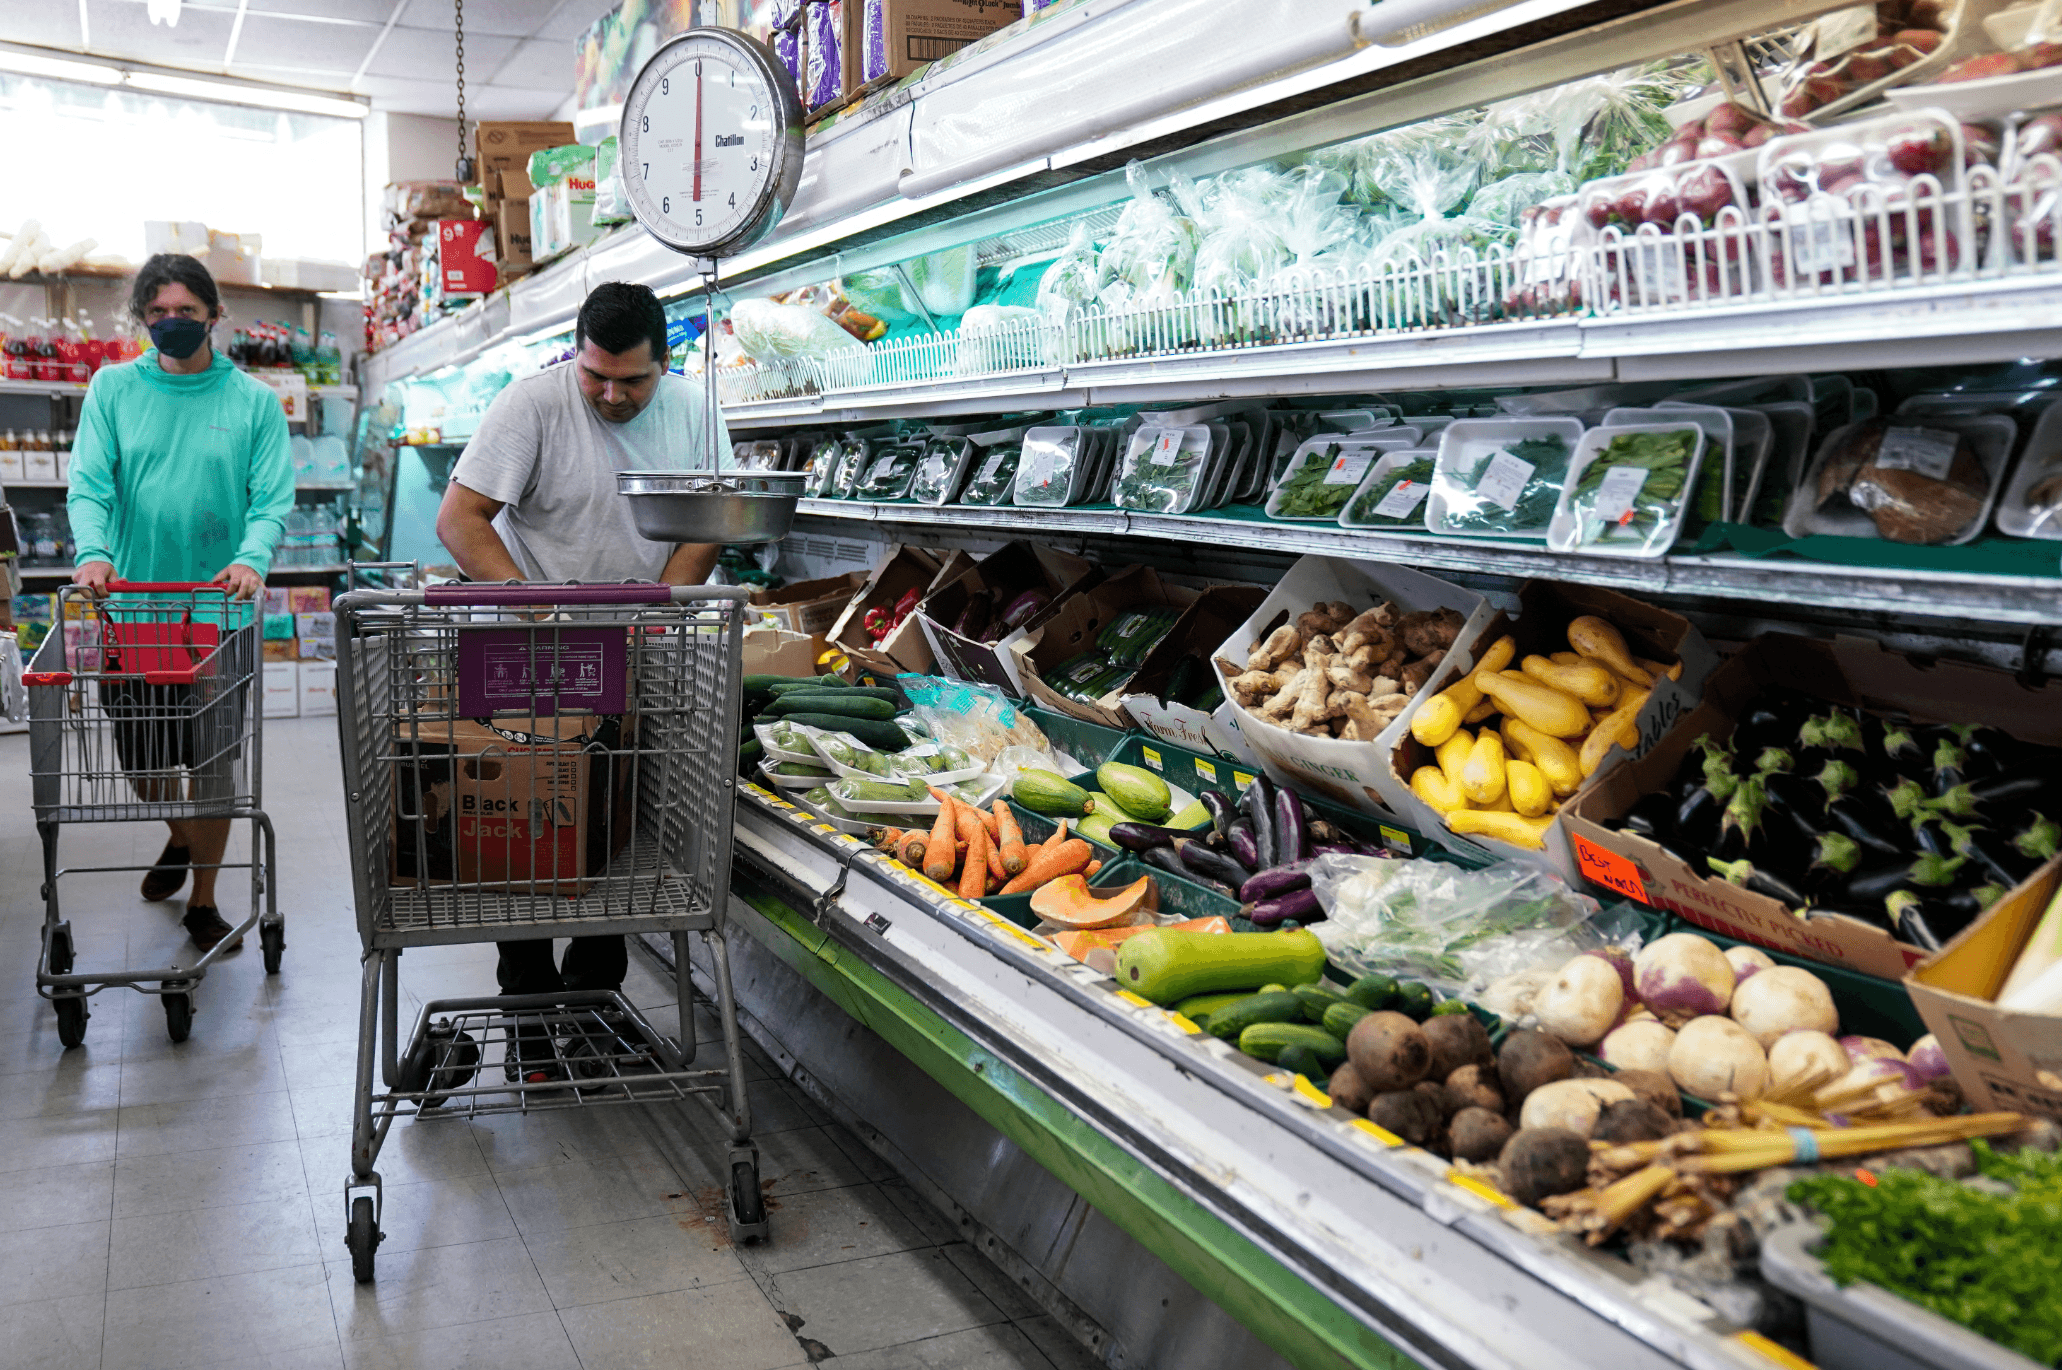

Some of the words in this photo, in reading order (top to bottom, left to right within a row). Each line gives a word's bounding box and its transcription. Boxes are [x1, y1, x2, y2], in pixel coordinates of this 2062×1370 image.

[662, 78, 669, 96] 9
[750, 105, 758, 121] 2
[642, 116, 649, 133] 8
[715, 133, 744, 147] Chatillon
[642, 163, 649, 181] 7
[750, 154, 758, 172] 3
[662, 196, 670, 214] 6
[728, 192, 736, 209] 4
[695, 208, 702, 226] 5
[1140, 711, 1177, 736] Farm
[1174, 718, 1207, 746] Fresh
[401, 762, 430, 770] BUSEL
[1290, 755, 1360, 783] GINGER
[463, 820, 523, 839] Jack
[1670, 878, 1763, 929] PERFECTLY
[1768, 918, 1845, 958] PICKED
